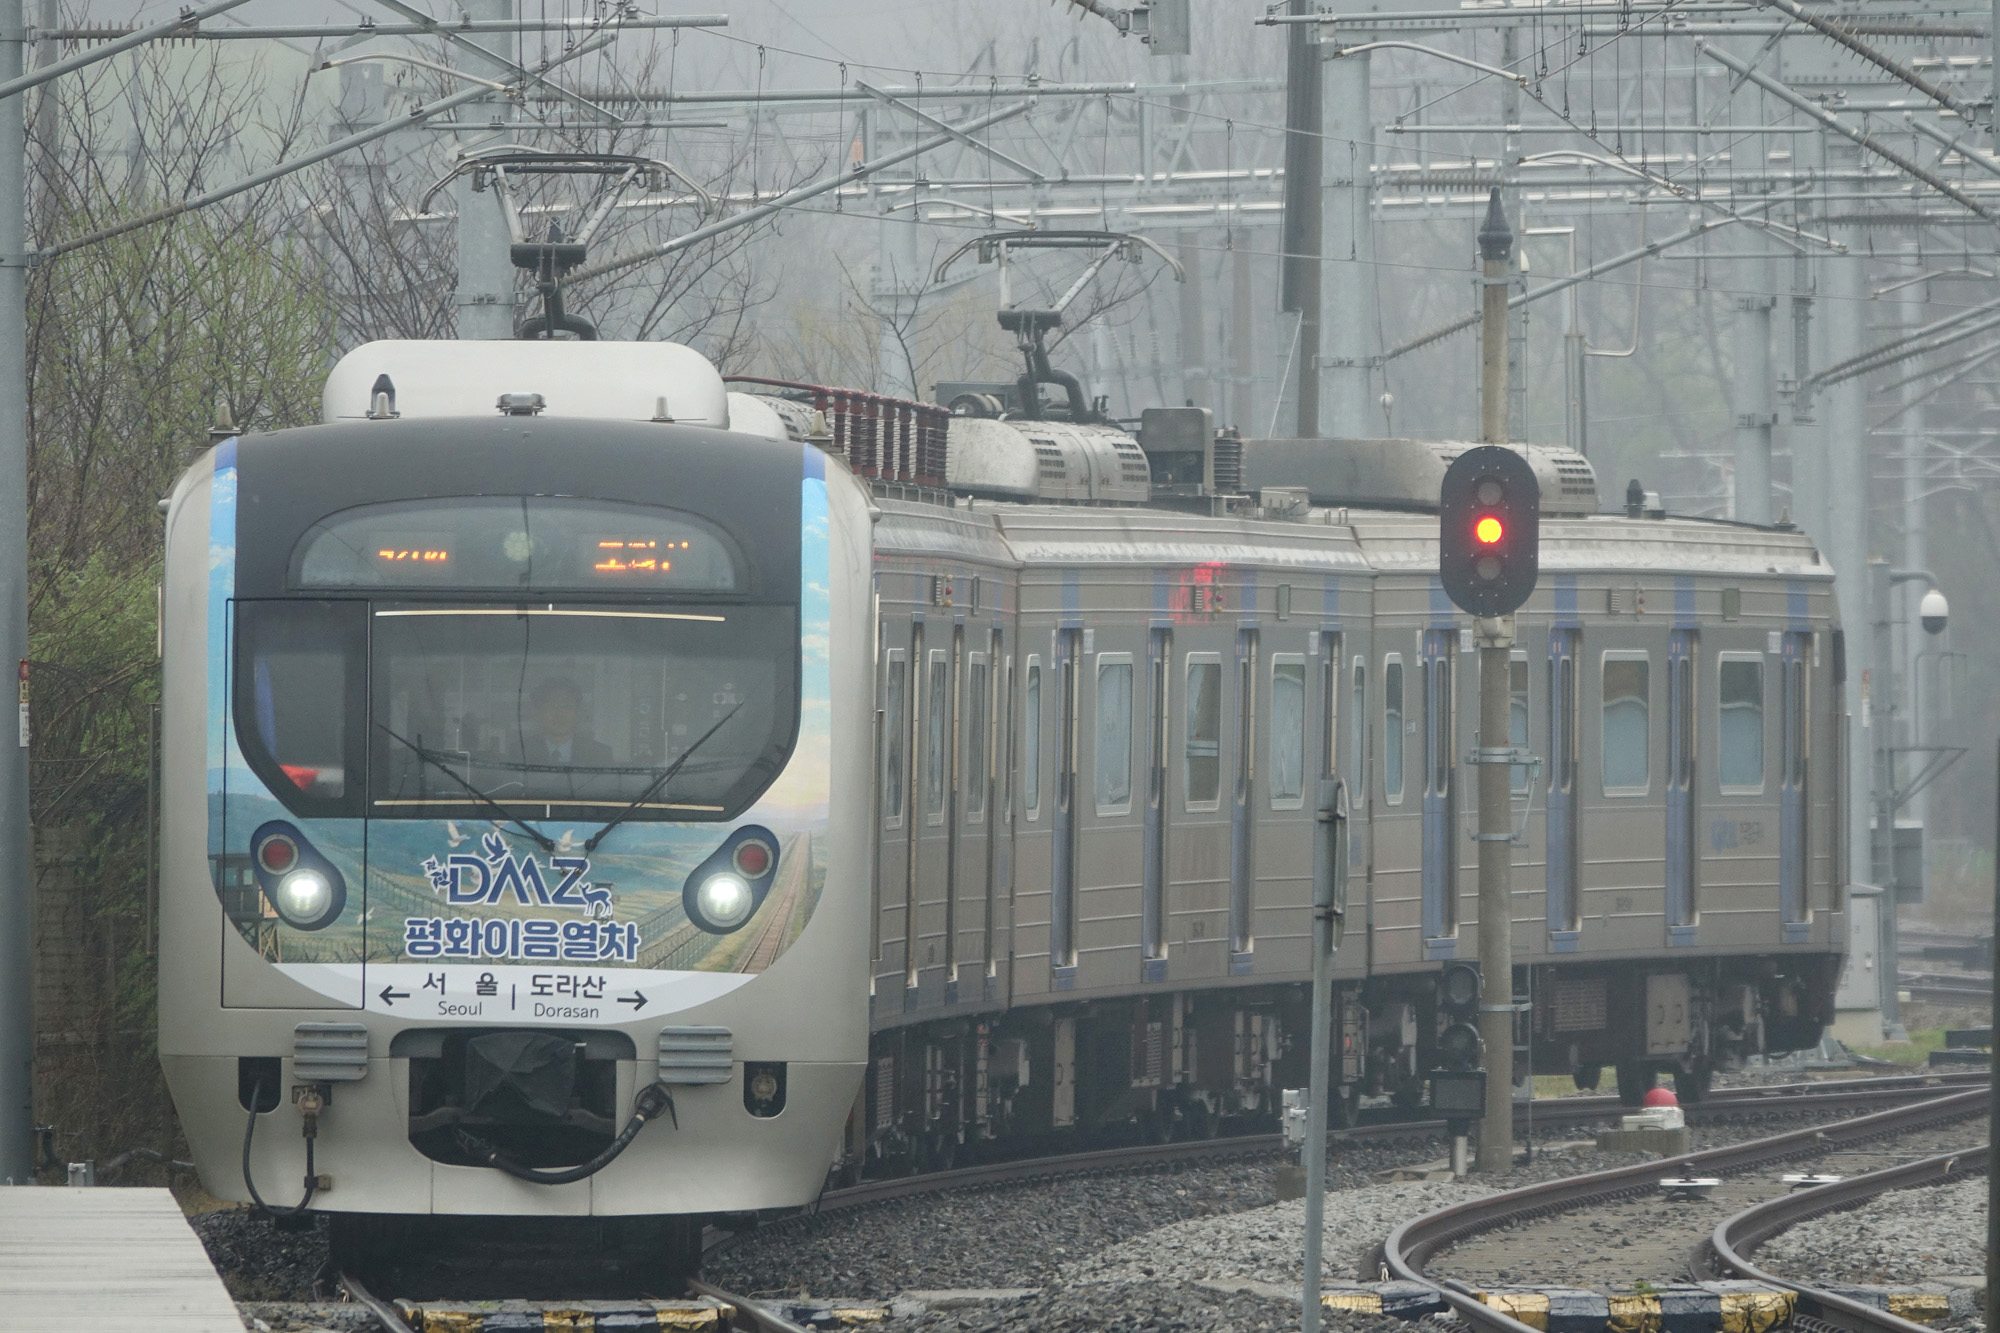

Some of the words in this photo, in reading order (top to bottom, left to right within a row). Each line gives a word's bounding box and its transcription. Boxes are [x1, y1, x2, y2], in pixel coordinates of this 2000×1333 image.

[447, 853, 591, 907] DMZ
[404, 917, 642, 962] 평화이음열차
[530, 974, 607, 999] 도라산
[438, 1001, 483, 1016] Seoul
[534, 1003, 600, 1019] Dorasan
